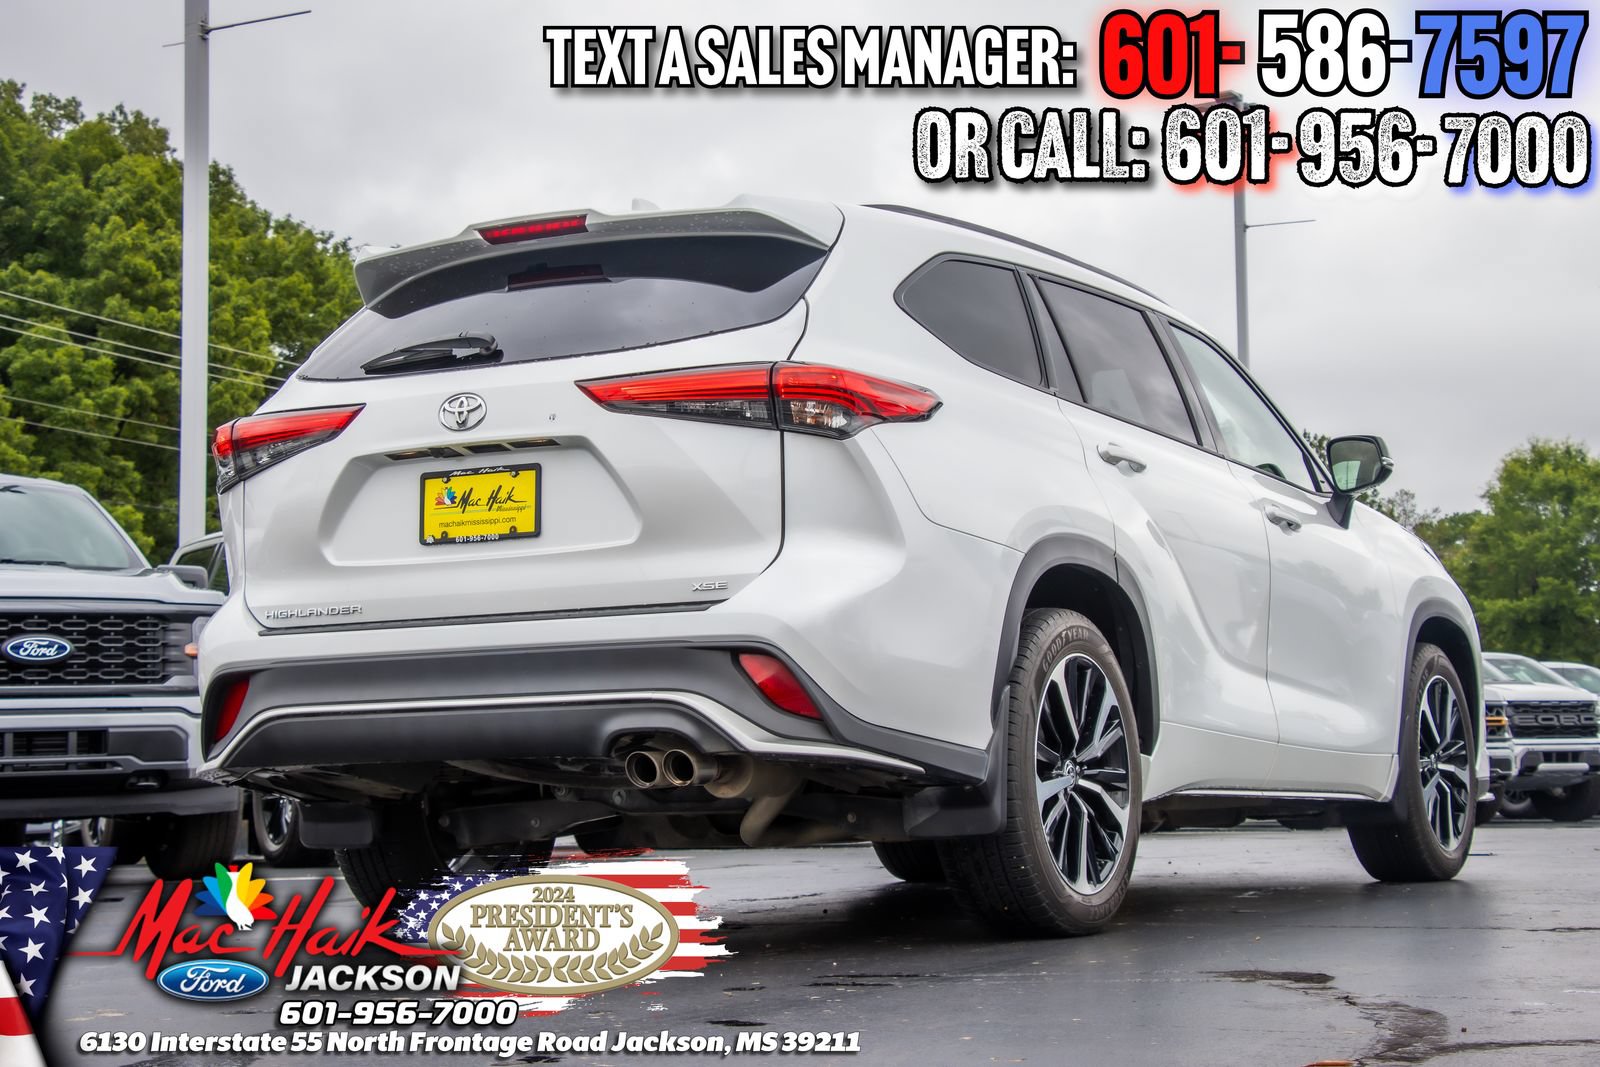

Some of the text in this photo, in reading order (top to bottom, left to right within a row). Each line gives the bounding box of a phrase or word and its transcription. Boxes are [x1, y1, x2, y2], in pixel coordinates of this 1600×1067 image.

[456, 485, 527, 514] Mac Haik
[438, 516, 517, 529] machaikmississippi.com
[691, 580, 729, 592] XSE
[264, 604, 363, 619] HIGHLANDER
[18, 638, 60, 658] Ford
